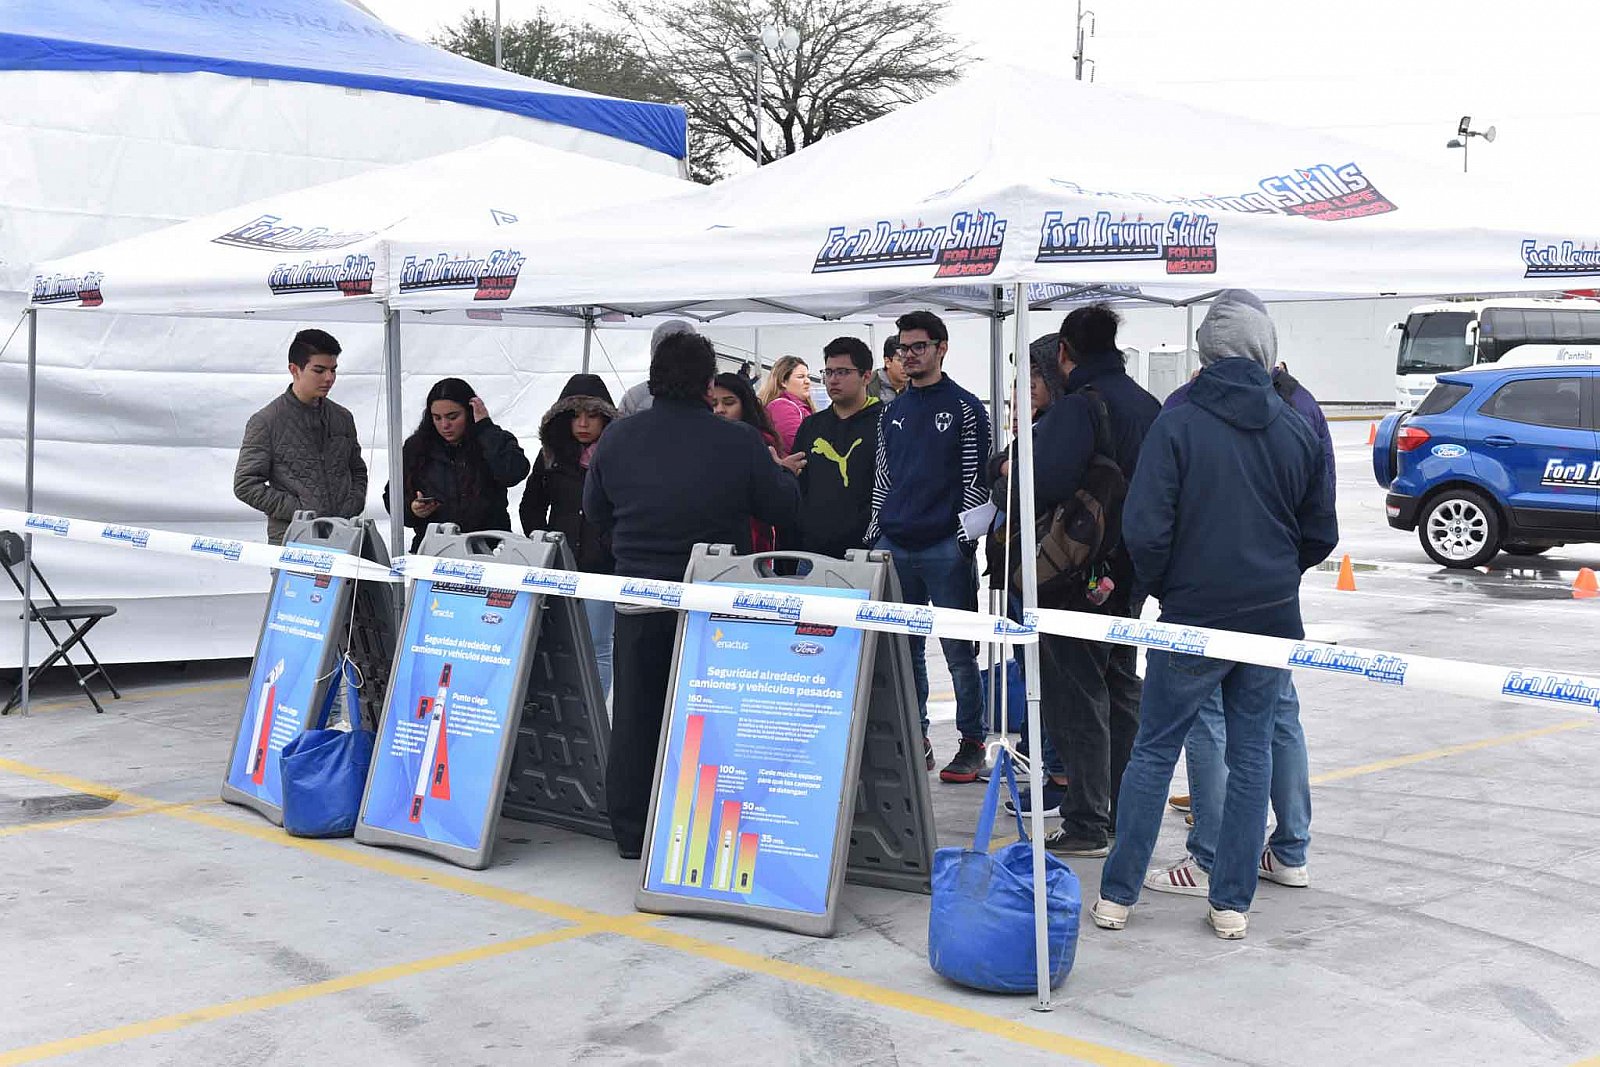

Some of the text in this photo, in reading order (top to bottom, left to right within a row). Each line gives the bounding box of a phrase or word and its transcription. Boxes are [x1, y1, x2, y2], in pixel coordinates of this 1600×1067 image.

[945, 211, 1008, 250] Skills
[1163, 212, 1219, 247] Skills
[943, 247, 999, 262] FOR LIFE
[1168, 247, 1214, 258] FOR LIFE
[707, 666, 826, 685] Seguridad alrededor de
[689, 678, 738, 691] camiones
[746, 682, 796, 696] vehículos
[796, 686, 844, 700] pesados
[719, 764, 736, 774] 100
[743, 801, 756, 811] 50
[760, 833, 773, 844] 35
